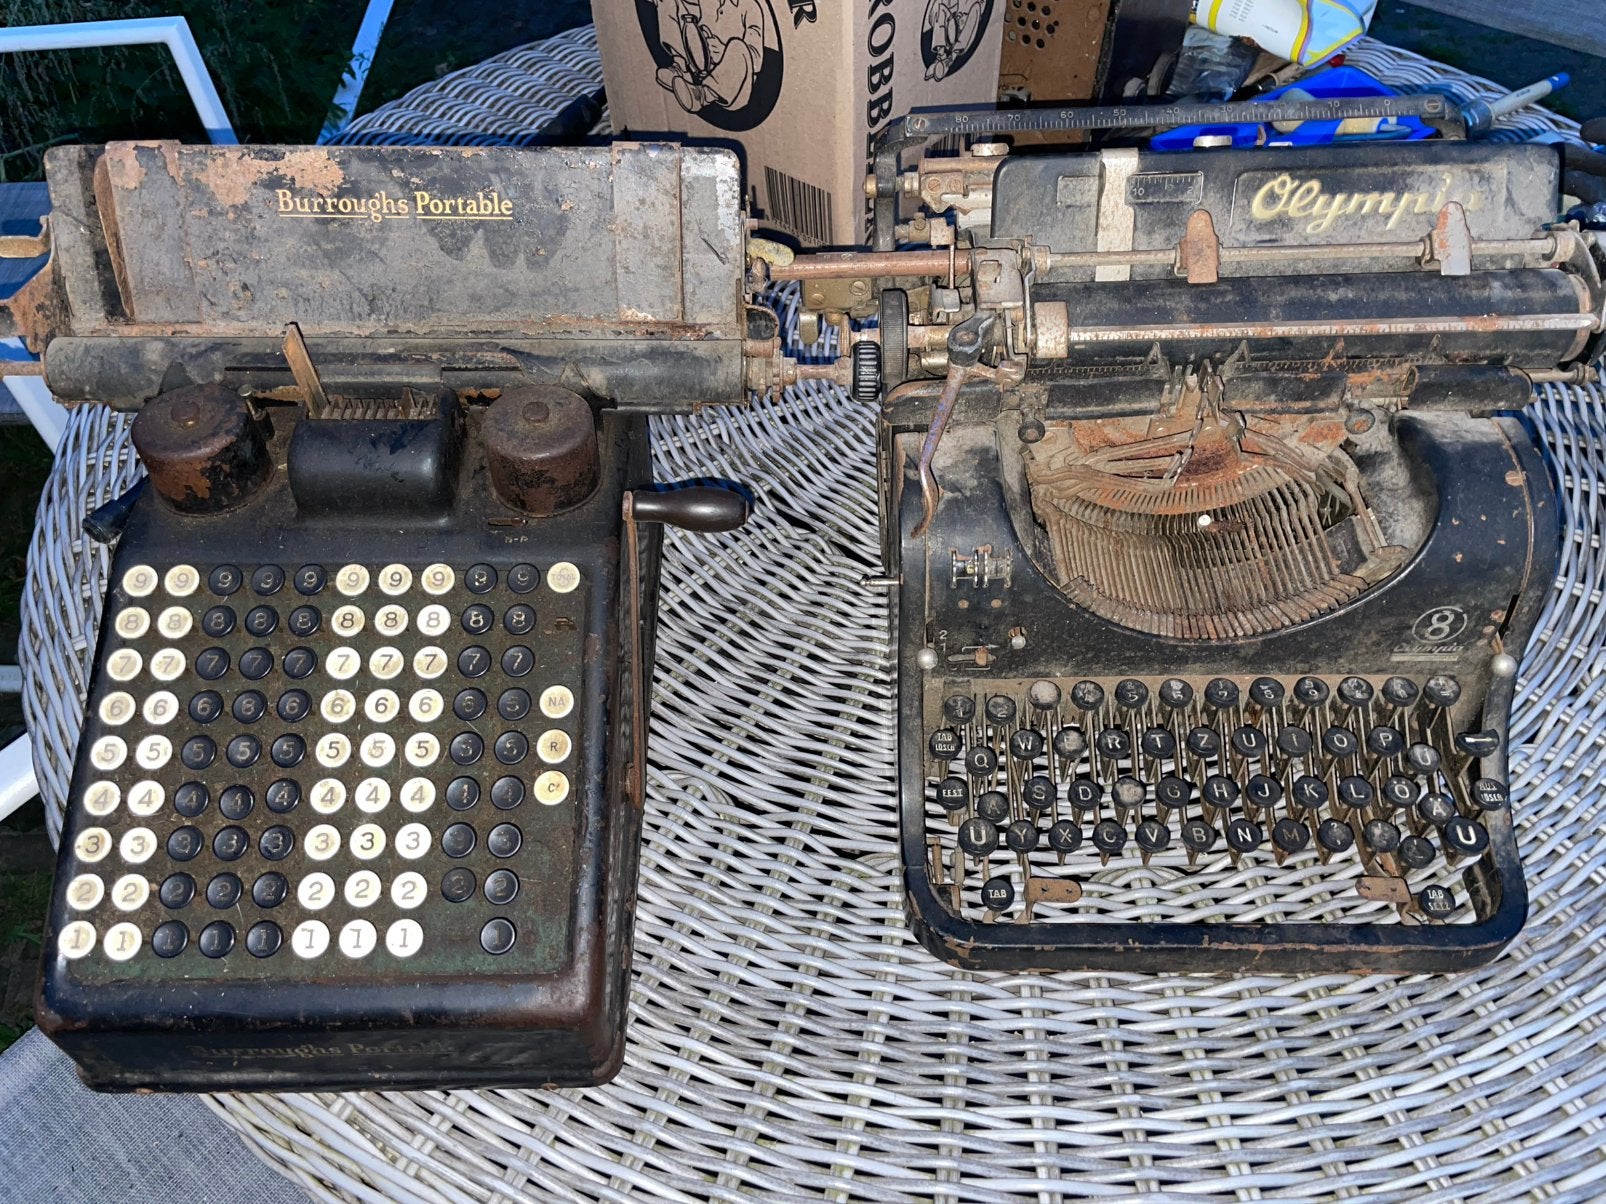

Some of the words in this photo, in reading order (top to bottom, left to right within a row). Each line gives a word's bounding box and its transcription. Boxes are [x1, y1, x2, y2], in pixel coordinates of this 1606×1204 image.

[1007, 114, 1020, 122] 70
[1061, 111, 1074, 119] 60
[1113, 108, 1126, 117] 50
[1220, 105, 1233, 113] 30
[1328, 100, 1340, 108] 10
[1132, 187, 1145, 196] 10
[276, 189, 409, 223] Burroughs
[414, 191, 513, 215] Portable
[134, 573, 148, 588] 9
[177, 573, 190, 588] 9
[218, 572, 233, 587] 9
[261, 572, 274, 588] 9
[304, 571, 317, 587] 9
[347, 572, 359, 587] 9
[390, 571, 402, 586] 9
[432, 571, 444, 586] 9
[125, 615, 138, 630] 8
[168, 614, 181, 630] 8
[212, 613, 224, 629] 8
[254, 613, 267, 628] 8
[297, 613, 311, 628] 8
[341, 613, 354, 628] 8
[384, 612, 397, 627] 8
[427, 611, 440, 628] 8
[470, 612, 483, 627] 8
[1425, 610, 1455, 640] 8
[940, 630, 948, 639] 2
[940, 643, 946, 654] 1
[120, 656, 132, 672] 7
[163, 656, 175, 672] 7
[207, 657, 219, 672] 7
[249, 656, 261, 672] 7
[292, 655, 306, 671] 7
[338, 655, 350, 671] 7
[380, 654, 393, 670] 7
[425, 654, 437, 670] 7
[469, 654, 481, 670] 7
[510, 653, 522, 669] 7
[110, 700, 123, 716] 6
[153, 699, 168, 716] 6
[331, 697, 344, 713] 6
[375, 697, 388, 713] 6
[419, 697, 432, 712] 6
[548, 697, 565, 707] NA
[937, 733, 952, 741] TAB
[101, 743, 116, 761] 5
[146, 743, 161, 760] 5
[237, 742, 250, 760] 5
[326, 742, 341, 758] 5
[368, 739, 386, 757] 5
[415, 740, 430, 757] 5
[550, 741, 558, 751] R
[975, 753, 989, 768] Q
[1018, 737, 1032, 750] W
[1107, 735, 1121, 749] R
[1150, 734, 1165, 748] T
[1197, 734, 1212, 748] Z
[1242, 733, 1256, 747] U
[1292, 733, 1298, 747] I
[1333, 734, 1348, 747] O
[1380, 732, 1392, 746] P
[93, 789, 108, 805] 4
[138, 789, 153, 805] 4
[184, 792, 197, 808] 4
[275, 787, 288, 805] 4
[321, 786, 335, 805] 4
[365, 786, 379, 804] 4
[410, 785, 424, 804] 4
[547, 783, 556, 793] C
[942, 789, 963, 797] FEST
[986, 801, 1001, 815] A
[1033, 785, 1046, 799] S
[1079, 786, 1092, 800] D
[1167, 785, 1181, 797] G
[1213, 783, 1229, 797] H
[1258, 783, 1270, 797] J
[1304, 783, 1319, 797] K
[1350, 784, 1365, 798] L
[1395, 781, 1410, 798] Ö
[1429, 798, 1448, 816] Ä
[86, 835, 100, 853] 3
[130, 836, 145, 854] 3
[178, 835, 190, 853] 3
[271, 833, 283, 851] 3
[315, 833, 329, 851] 3
[360, 832, 374, 850] 3
[406, 832, 420, 849] 3
[969, 826, 988, 846] U
[1015, 828, 1028, 842] Y
[1059, 829, 1072, 843] X
[1103, 829, 1116, 842] C
[1145, 828, 1159, 842] V
[1192, 828, 1207, 842] B
[1237, 827, 1252, 842] N
[1282, 828, 1300, 842] M
[1456, 825, 1477, 845] U
[77, 883, 92, 901] 2
[122, 883, 137, 902] 2
[169, 882, 184, 901] 2
[217, 882, 232, 901] 2
[308, 882, 324, 901] 2
[355, 879, 370, 898] 2
[401, 880, 416, 900] 2
[988, 888, 1007, 899] TAB
[1427, 890, 1444, 899] TAB
[70, 929, 81, 949] 1
[117, 931, 127, 950] 1
[163, 931, 173, 949] 1
[211, 930, 220, 949] 1
[257, 930, 267, 949] 1
[302, 928, 315, 949] 1
[350, 928, 362, 948] 1
[399, 928, 408, 948] 1
